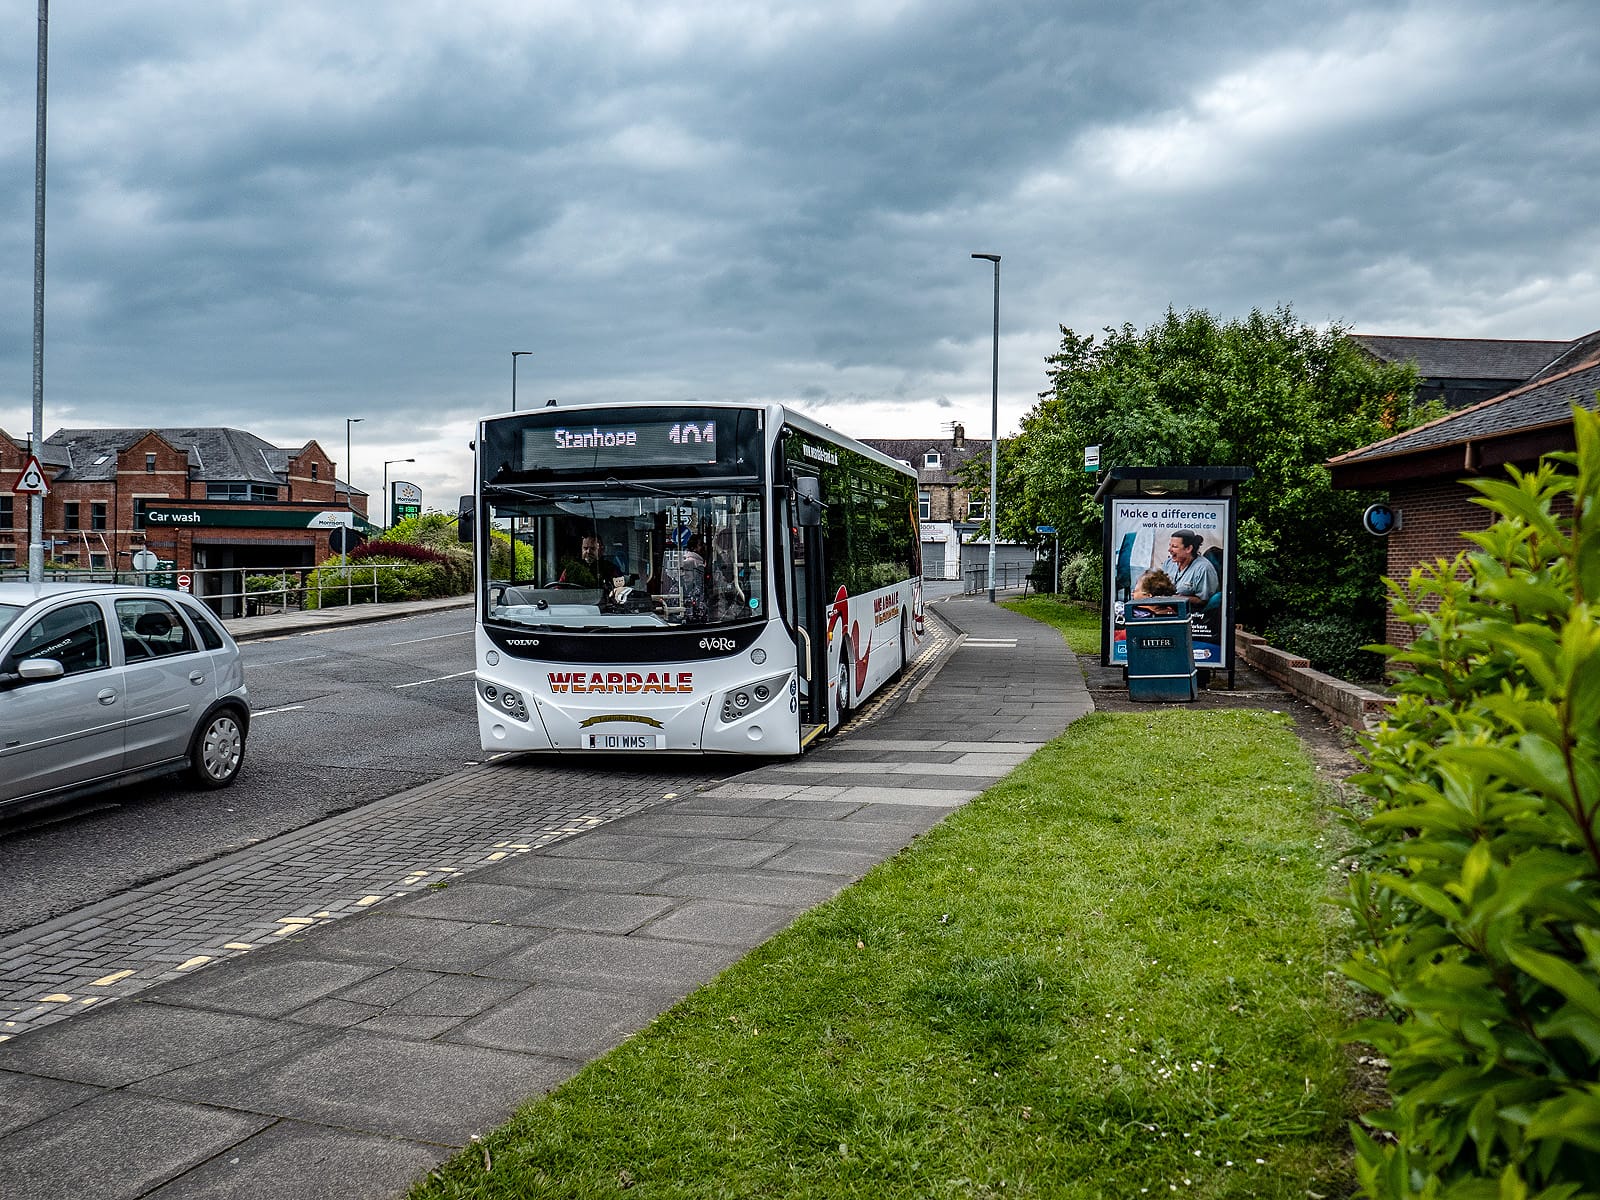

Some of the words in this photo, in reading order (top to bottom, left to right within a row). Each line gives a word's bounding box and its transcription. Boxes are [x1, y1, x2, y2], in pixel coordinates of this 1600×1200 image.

[554, 428, 637, 448] Stanhope
[149, 511, 170, 521] Car
[171, 511, 201, 522] wash
[1120, 508, 1149, 519] Make
[1151, 510, 1158, 519] a
[1161, 508, 1217, 520] difference
[547, 672, 694, 694] WEARDALE
[622, 736, 647, 748] WMS
